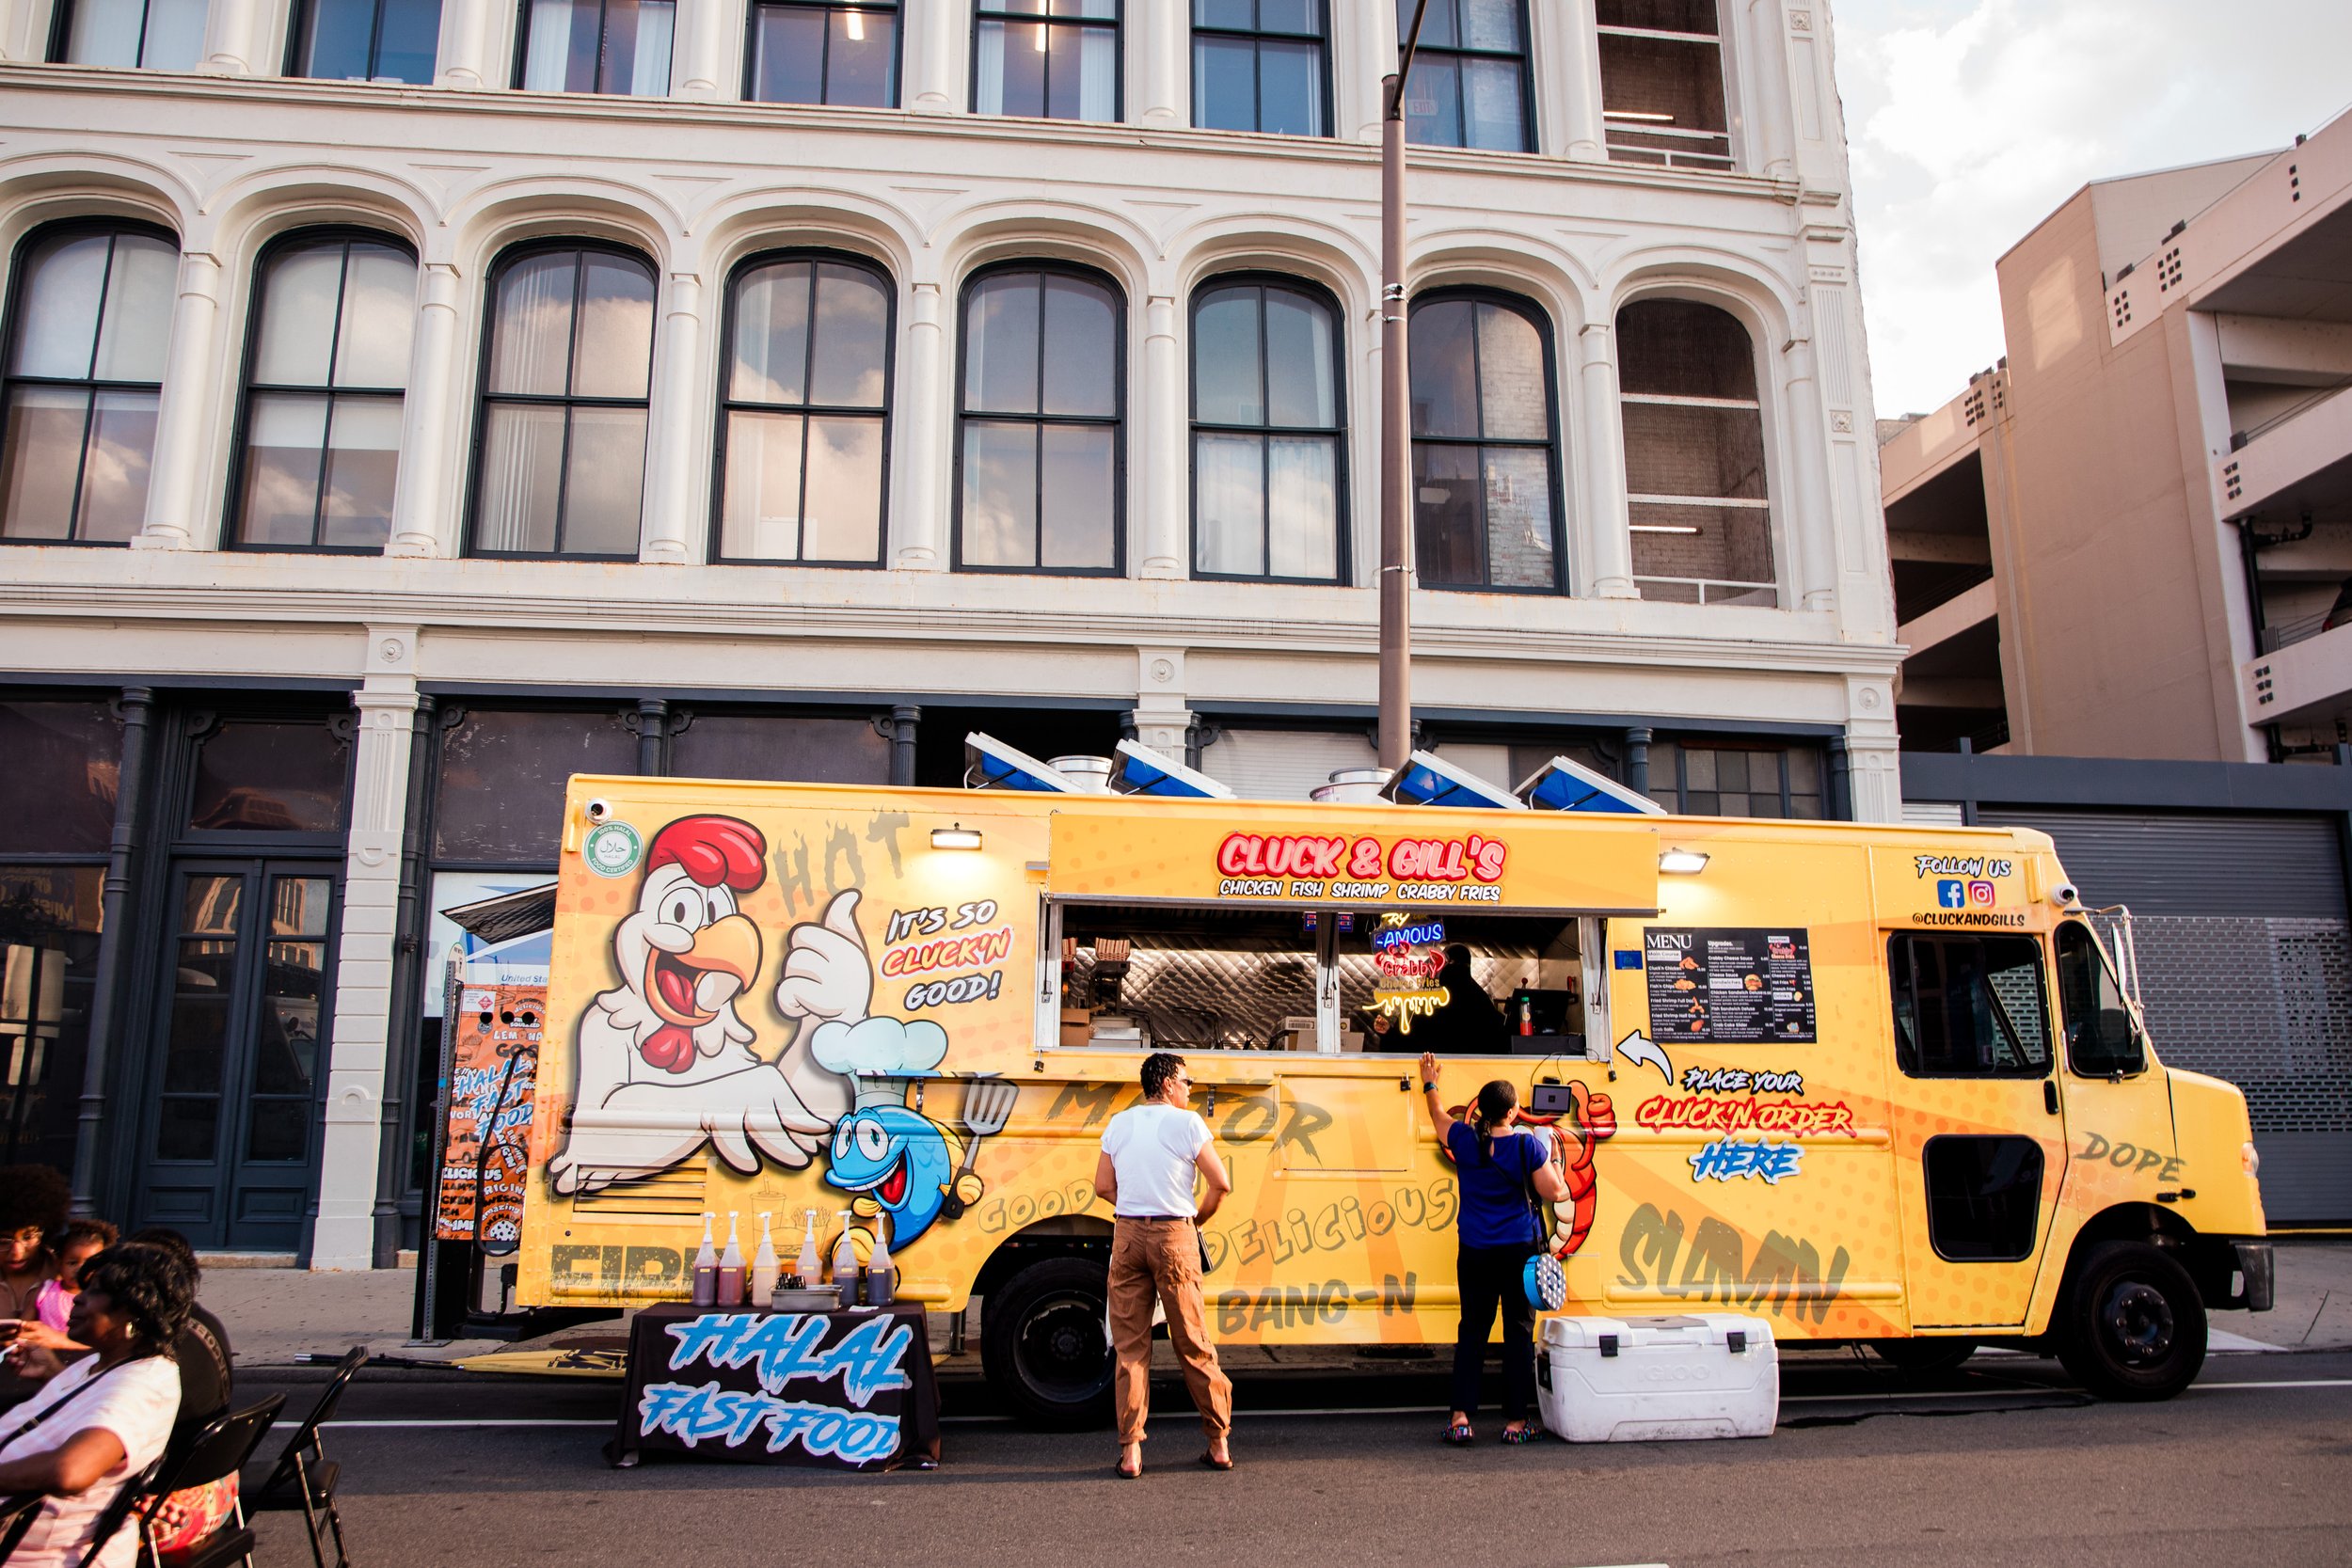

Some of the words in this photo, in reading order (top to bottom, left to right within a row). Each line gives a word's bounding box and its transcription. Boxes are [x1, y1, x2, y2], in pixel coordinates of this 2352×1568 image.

[600, 839, 627, 853] حلال
[613, 825, 632, 836] HALAL
[591, 857, 606, 871] FOOD
[772, 805, 910, 919] HOT
[1216, 833, 1346, 878] CLUCK
[1348, 836, 1383, 879] &
[1388, 833, 1505, 882] GILL'S
[1914, 854, 1984, 879] FOLLOW
[1987, 859, 2012, 879] US
[1218, 879, 1284, 896] CHICKEN
[1290, 880, 1325, 897] FISH
[1330, 881, 1391, 898] SHRIMP
[1397, 882, 1457, 900] CRABBY
[1459, 883, 1502, 901] FRIES
[885, 907, 947, 945] IT'S
[949, 899, 998, 930] SO
[1645, 933, 1692, 949] MENU
[1913, 912, 2026, 927] @CLUCKANDGILLS
[881, 926, 1013, 979] CLUCK'N
[1383, 959, 1437, 979] Crabby
[501, 974, 532, 983] United
[904, 970, 1003, 1012] GOOD!
[1682, 1067, 1752, 1095] PLACE
[1750, 1069, 1805, 1096] YOUR
[1636, 1094, 1756, 1134] CLUCK'N
[1755, 1099, 1858, 1137] ORDER
[1688, 1135, 1804, 1185] HERE
[2073, 1131, 2188, 1182] DOPE
[978, 1178, 1097, 1234] GOOD
[1201, 1178, 1460, 1276] DELICIOUS
[1216, 1270, 1417, 1335] BANG-N
[664, 1313, 914, 1408] HALAL
[638, 1380, 785, 1449] FAST
